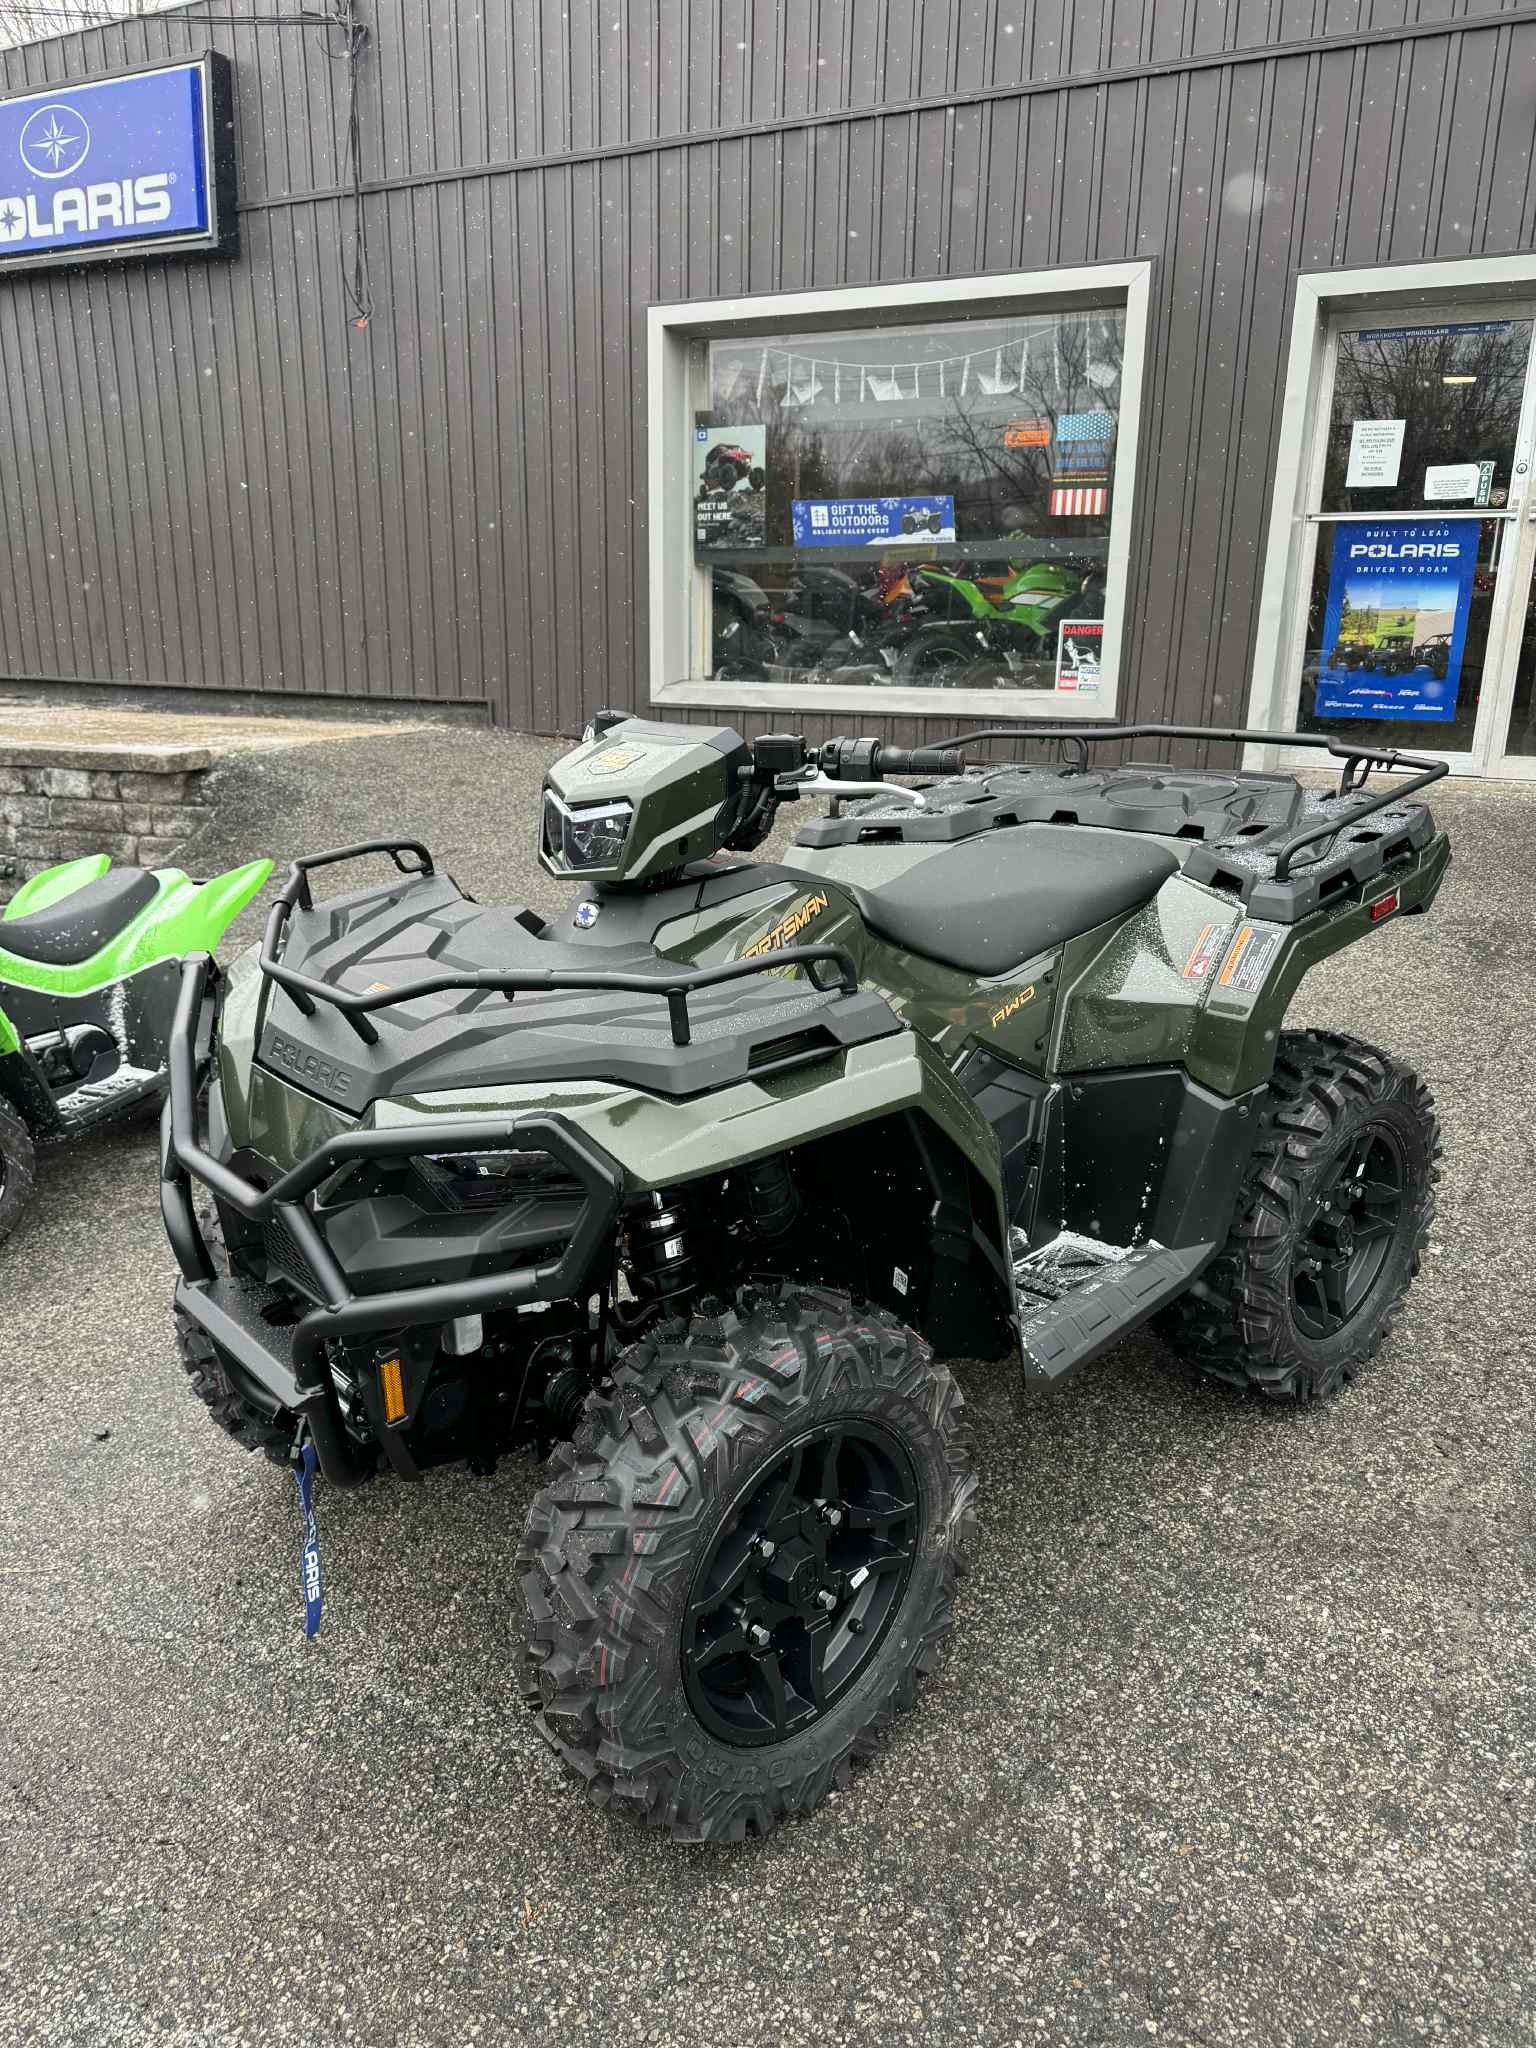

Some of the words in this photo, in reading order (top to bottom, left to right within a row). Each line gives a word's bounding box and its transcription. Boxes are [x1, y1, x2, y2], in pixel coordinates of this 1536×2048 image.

[1477, 475, 1490, 503] PUSH
[697, 513, 712, 521] OUT
[831, 504, 855, 516] GIFT
[858, 504, 878, 515] THE
[832, 515, 889, 527] OUTDOORS
[1350, 543, 1460, 558] POLARIS
[736, 889, 829, 960] ORTSMAN
[992, 984, 1035, 1029] AWD
[267, 1036, 352, 1097] POLARIS
